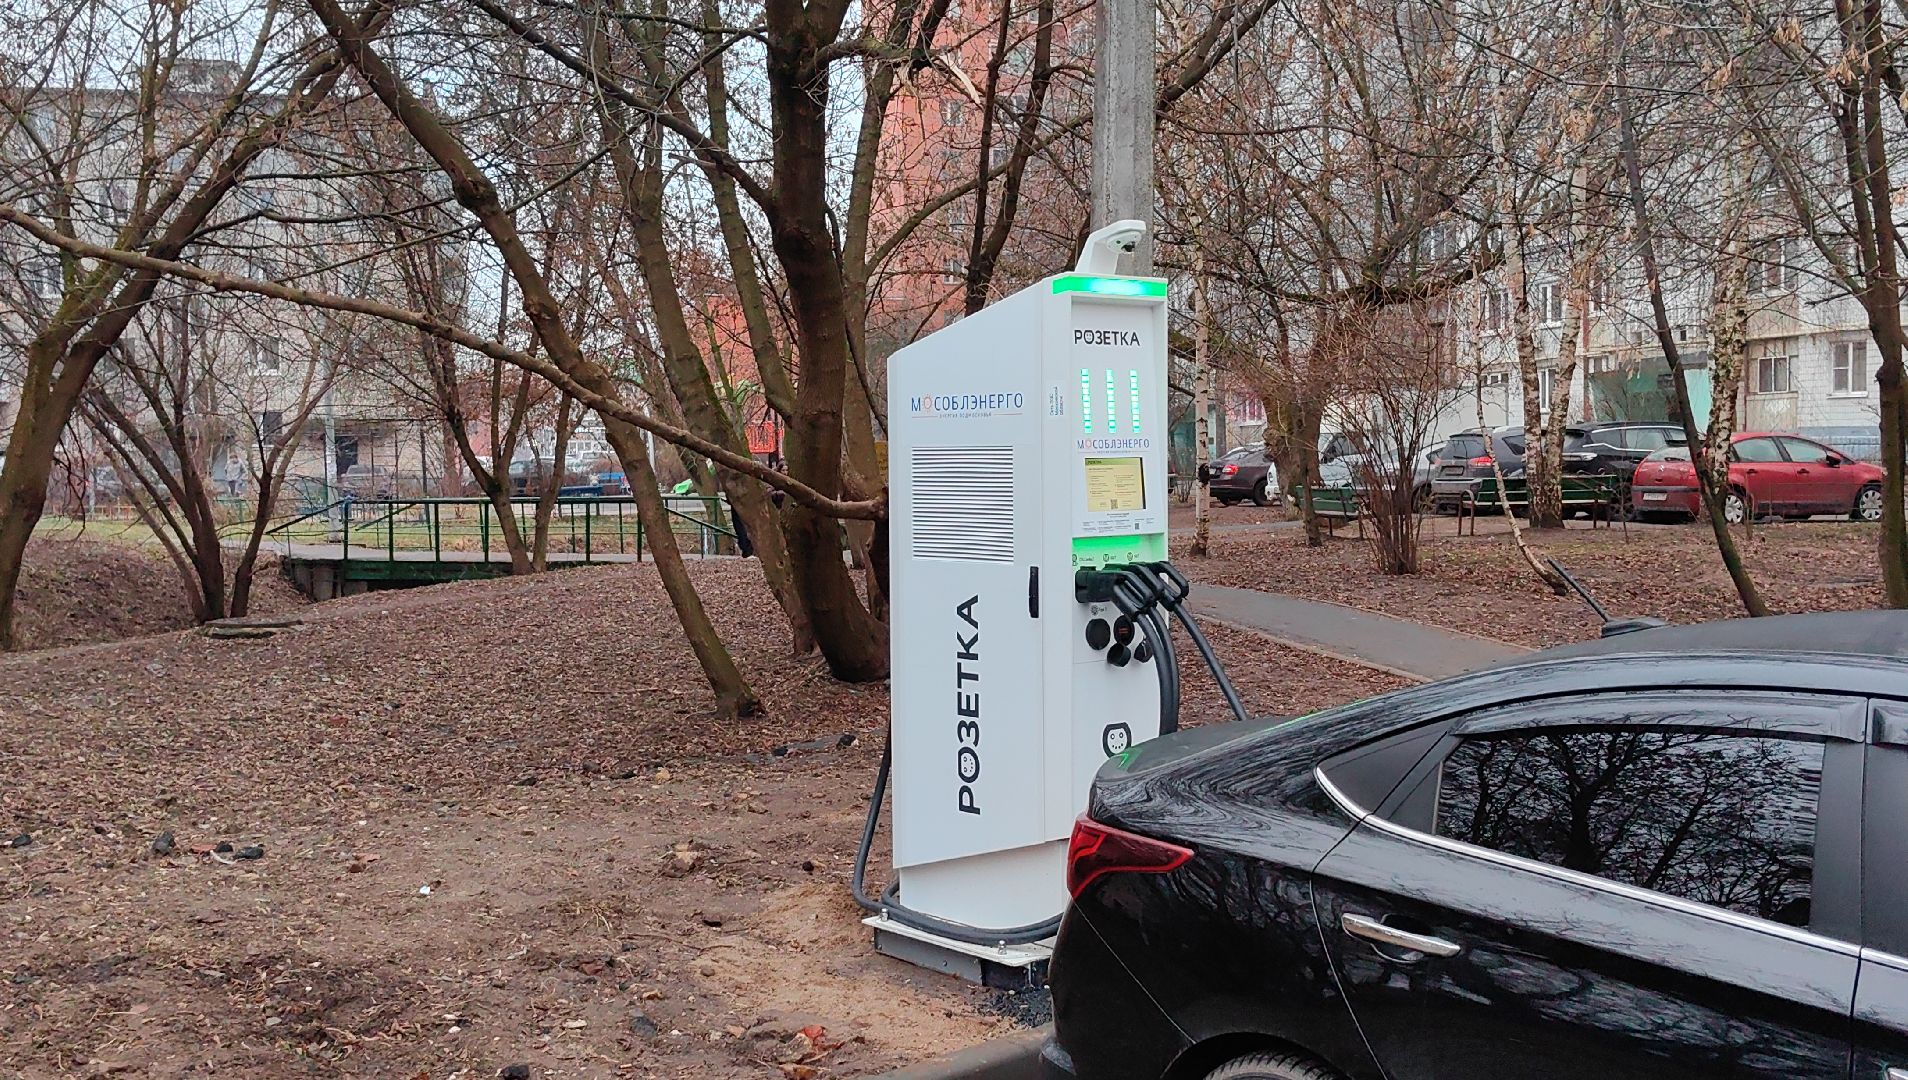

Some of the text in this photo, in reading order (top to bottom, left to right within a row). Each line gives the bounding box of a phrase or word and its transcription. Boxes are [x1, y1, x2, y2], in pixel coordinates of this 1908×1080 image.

[1074, 329, 1140, 346] РОЗЕТКА
[911, 392, 1023, 412] МОСОБЛЭНЕРГО
[1077, 438, 1150, 449] МОСОБЛЭНЕРГО
[956, 594, 981, 815] РОЗЕТКА
